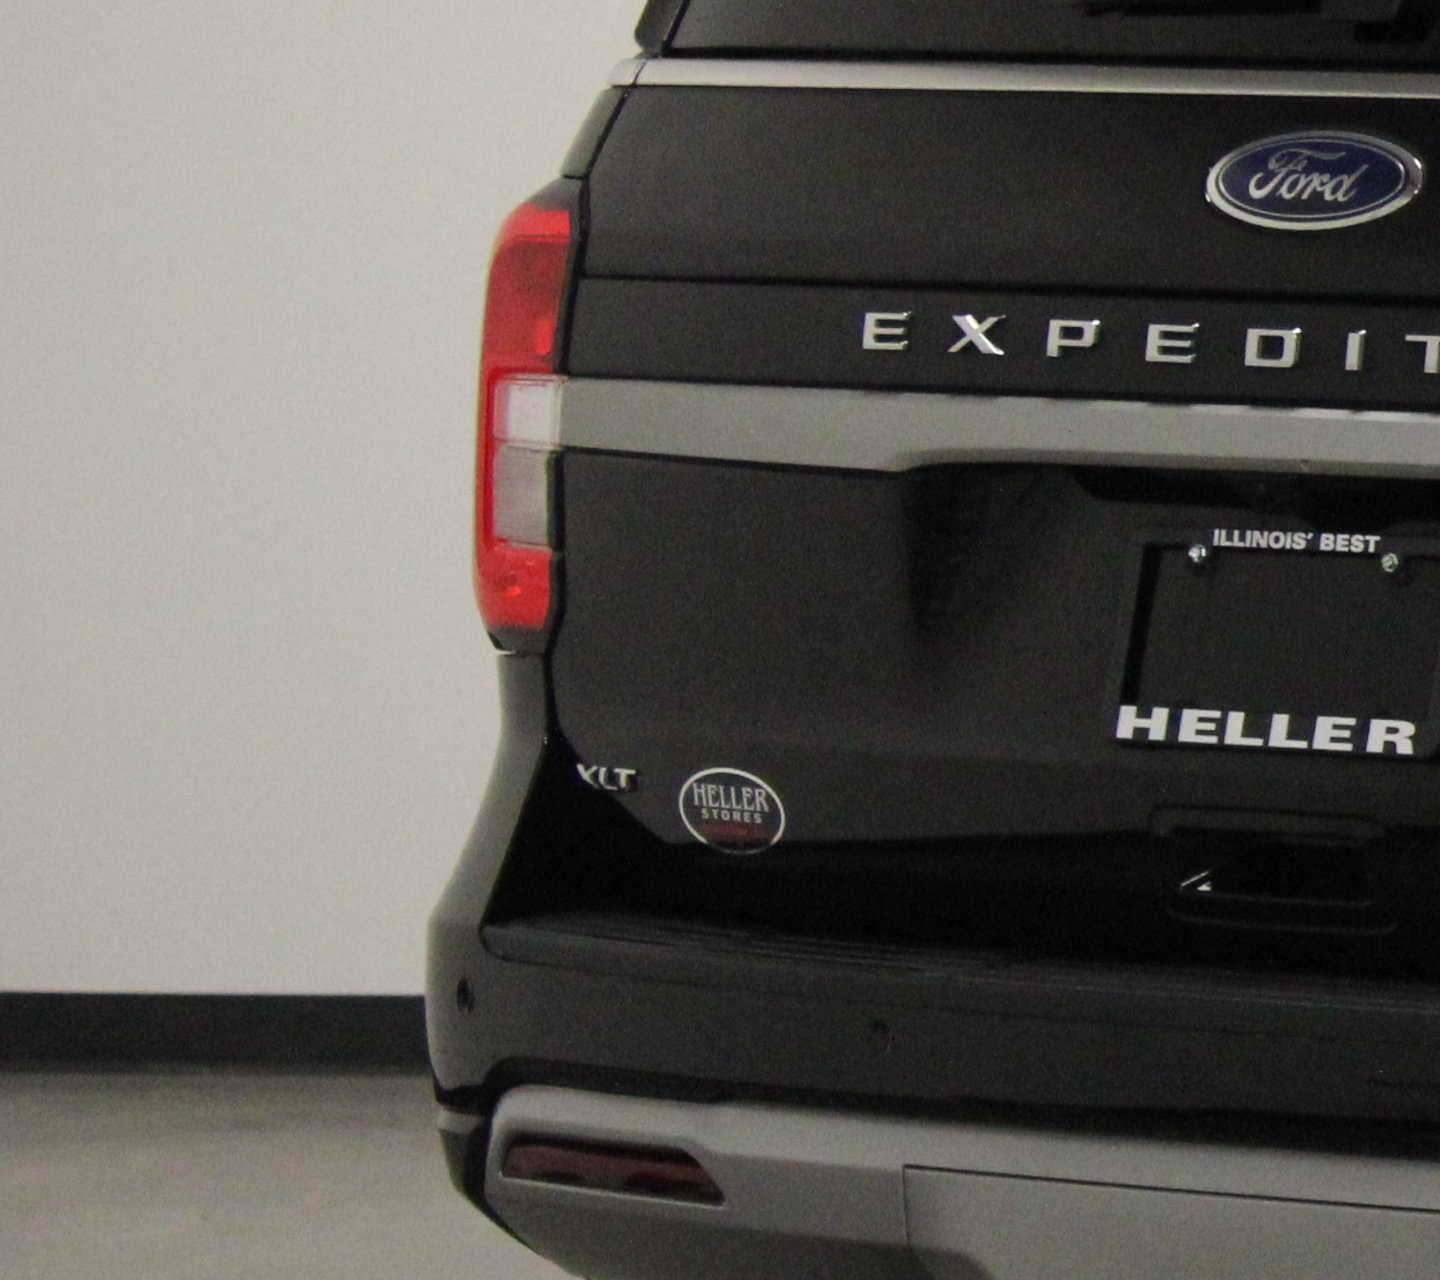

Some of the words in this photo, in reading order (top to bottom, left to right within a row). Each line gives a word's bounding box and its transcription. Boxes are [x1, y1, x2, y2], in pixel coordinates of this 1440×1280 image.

[1248, 147, 1369, 202] Ford
[1318, 532, 1381, 554] BEST
[1115, 704, 1417, 756] HELLER
[576, 763, 637, 791] XLT
[692, 782, 770, 813] HELLER
[701, 808, 763, 825] STORES
